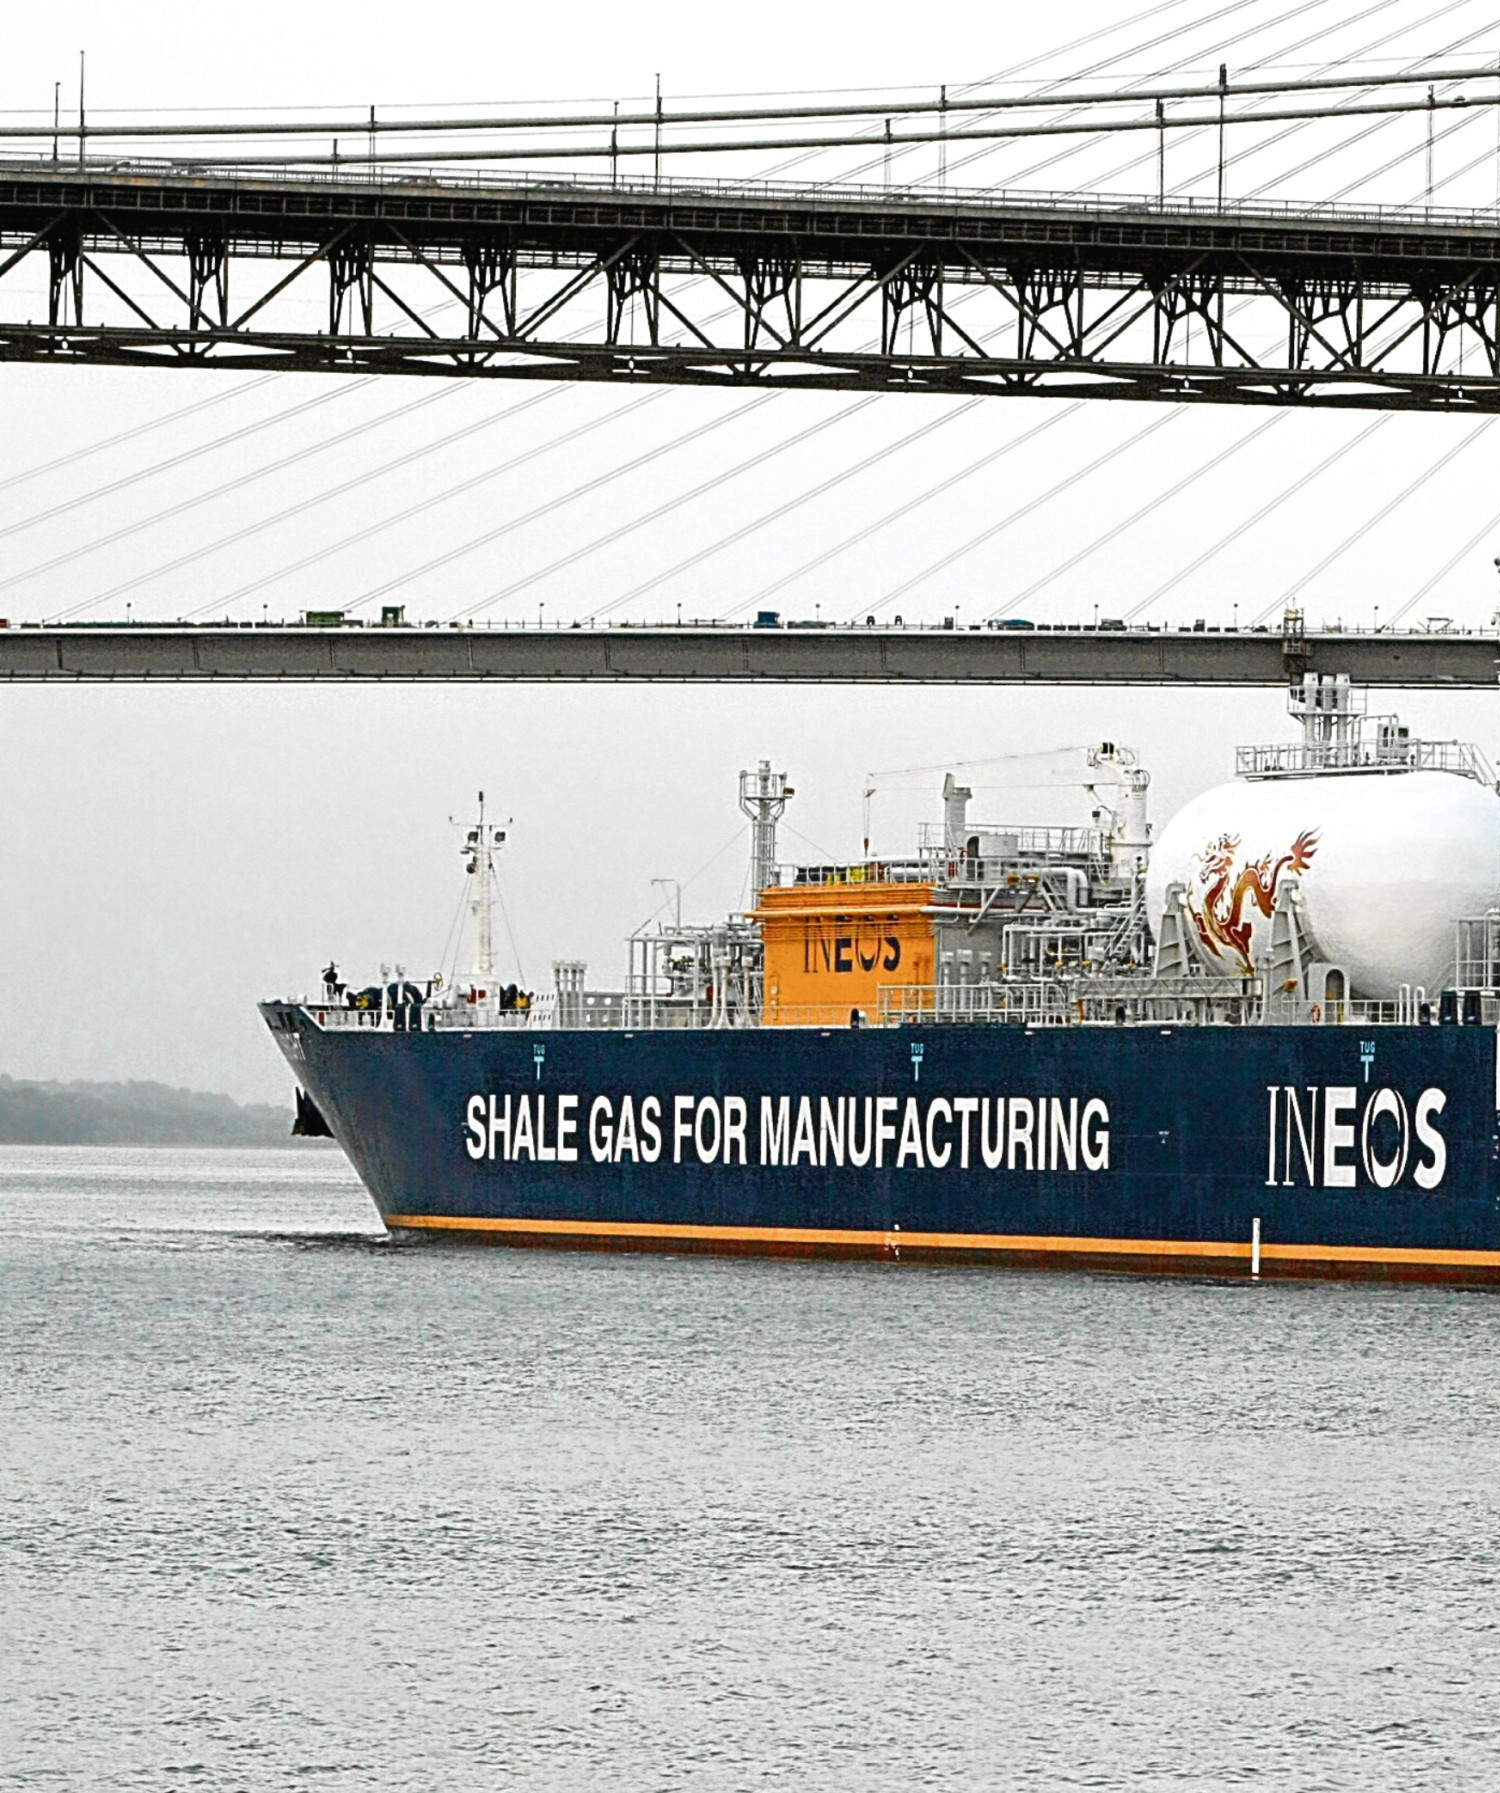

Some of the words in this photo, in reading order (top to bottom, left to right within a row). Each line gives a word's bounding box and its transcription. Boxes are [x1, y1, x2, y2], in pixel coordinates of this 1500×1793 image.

[803, 913, 901, 974] INEOS
[910, 1042, 925, 1055] TUG
[1360, 1041, 1376, 1054] TUG
[465, 1094, 579, 1162] SHALE
[588, 1095, 662, 1164] GAS
[673, 1095, 748, 1166] FOR
[760, 1095, 1111, 1171] MANUFACTURING
[1264, 1086, 1448, 1190] INEOS
